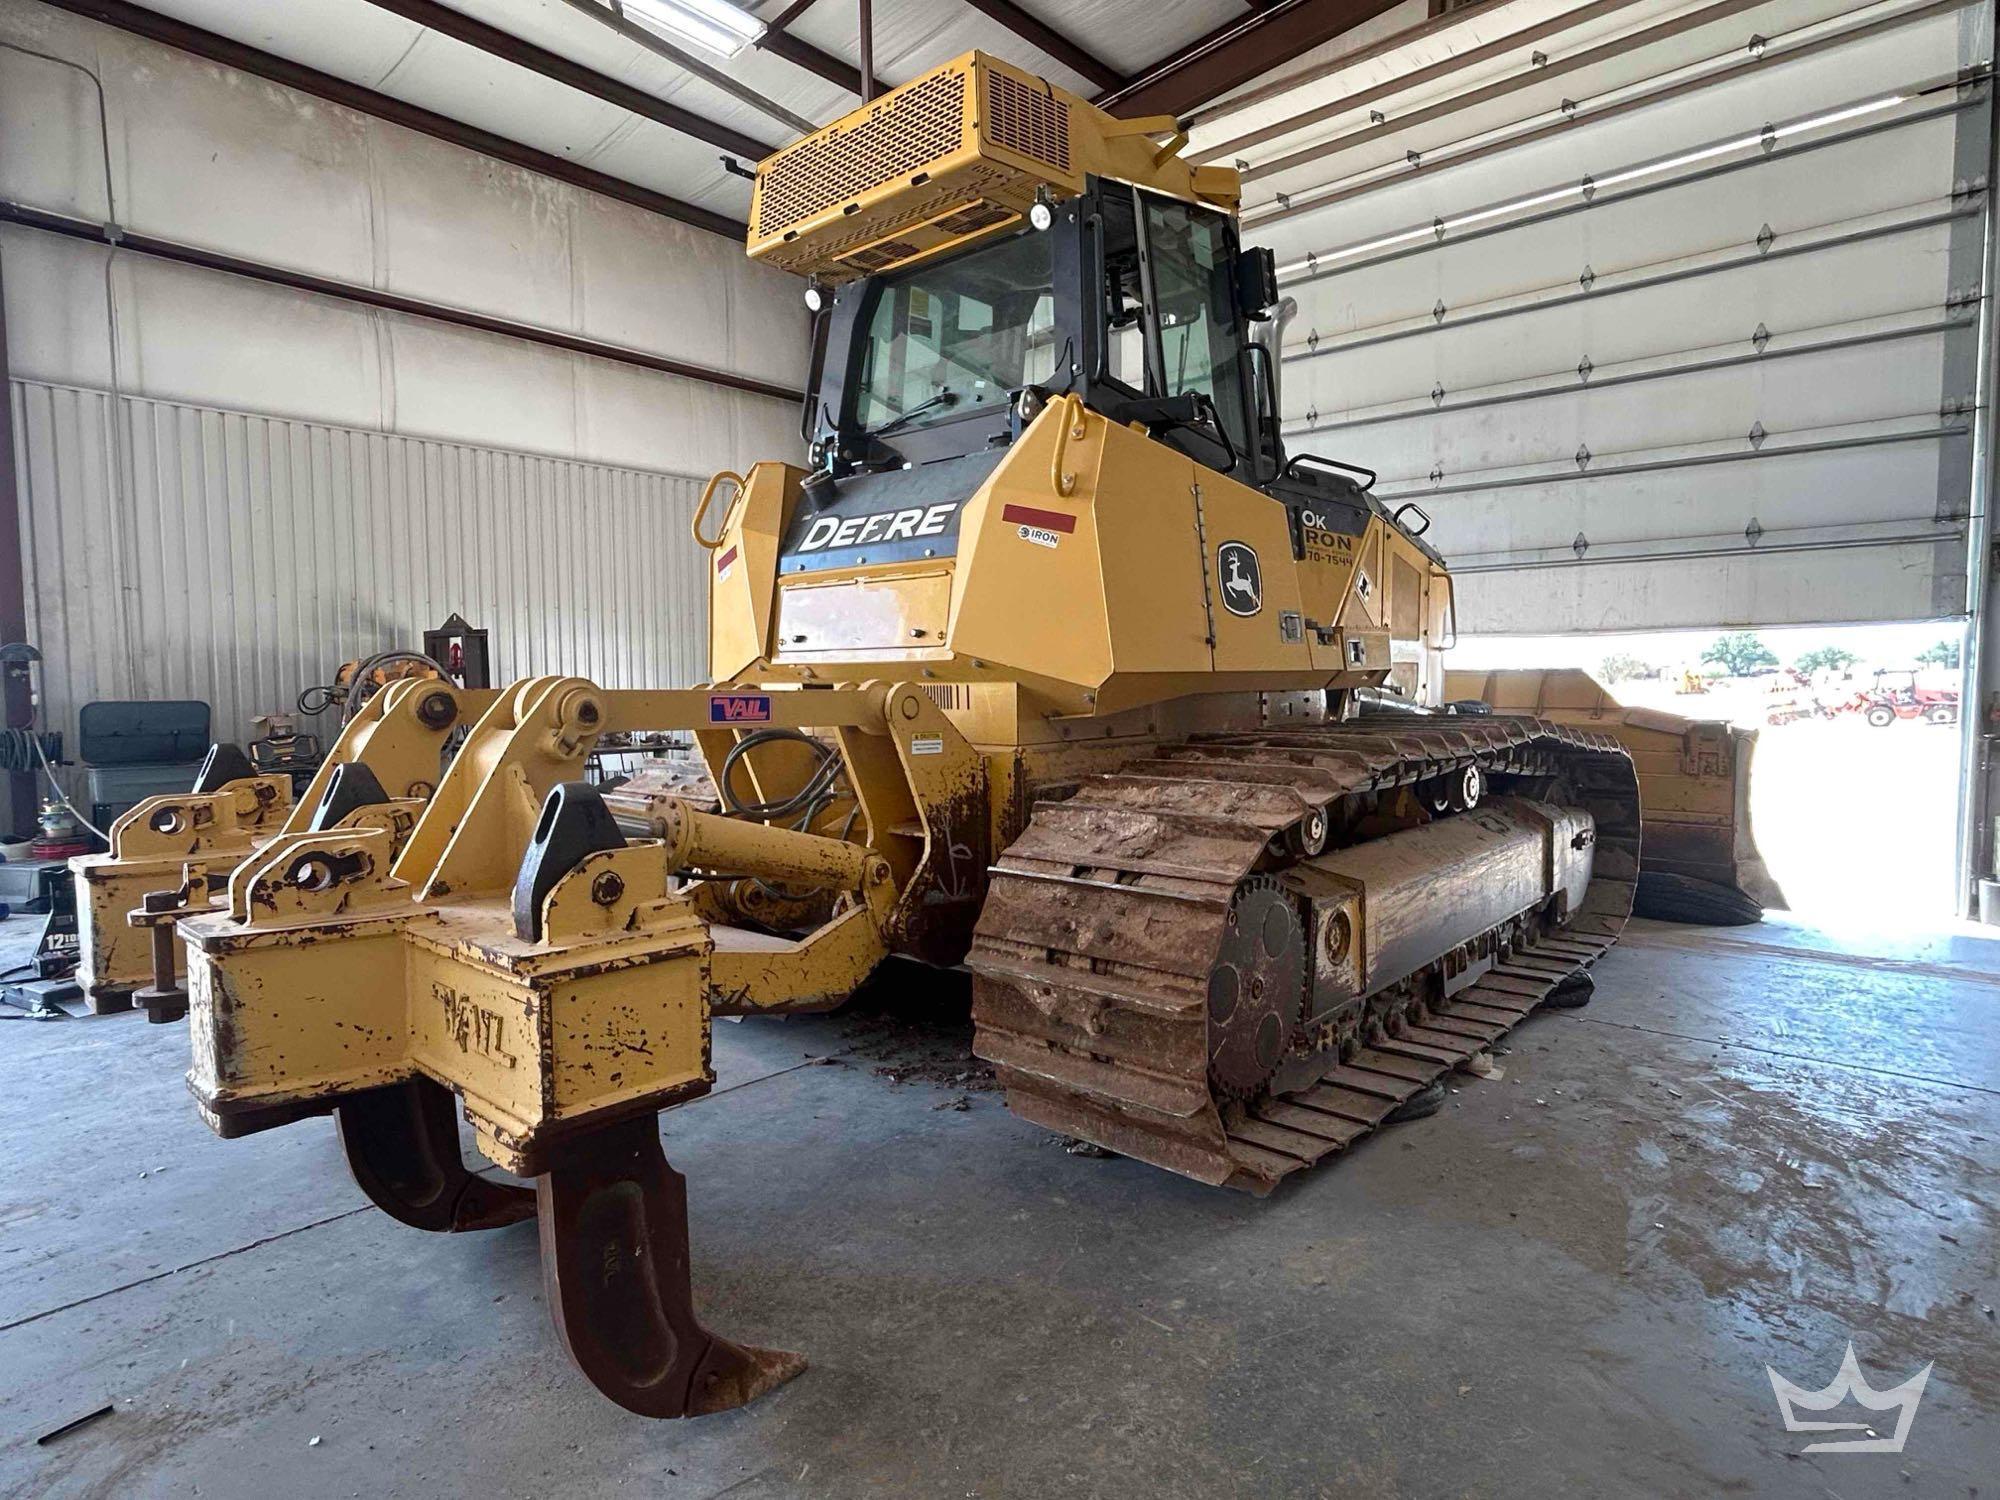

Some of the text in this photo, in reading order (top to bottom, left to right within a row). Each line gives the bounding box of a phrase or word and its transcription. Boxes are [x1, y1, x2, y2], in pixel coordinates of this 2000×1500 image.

[798, 503, 958, 552] DEERE
[1302, 510, 1327, 530] OK
[1031, 529, 1058, 544] IRON
[1306, 530, 1352, 551] RON
[1307, 551, 1353, 567] 70-7544
[713, 699, 768, 719] VAIL
[46, 934, 64, 950] 12
[64, 933, 79, 943] TO
